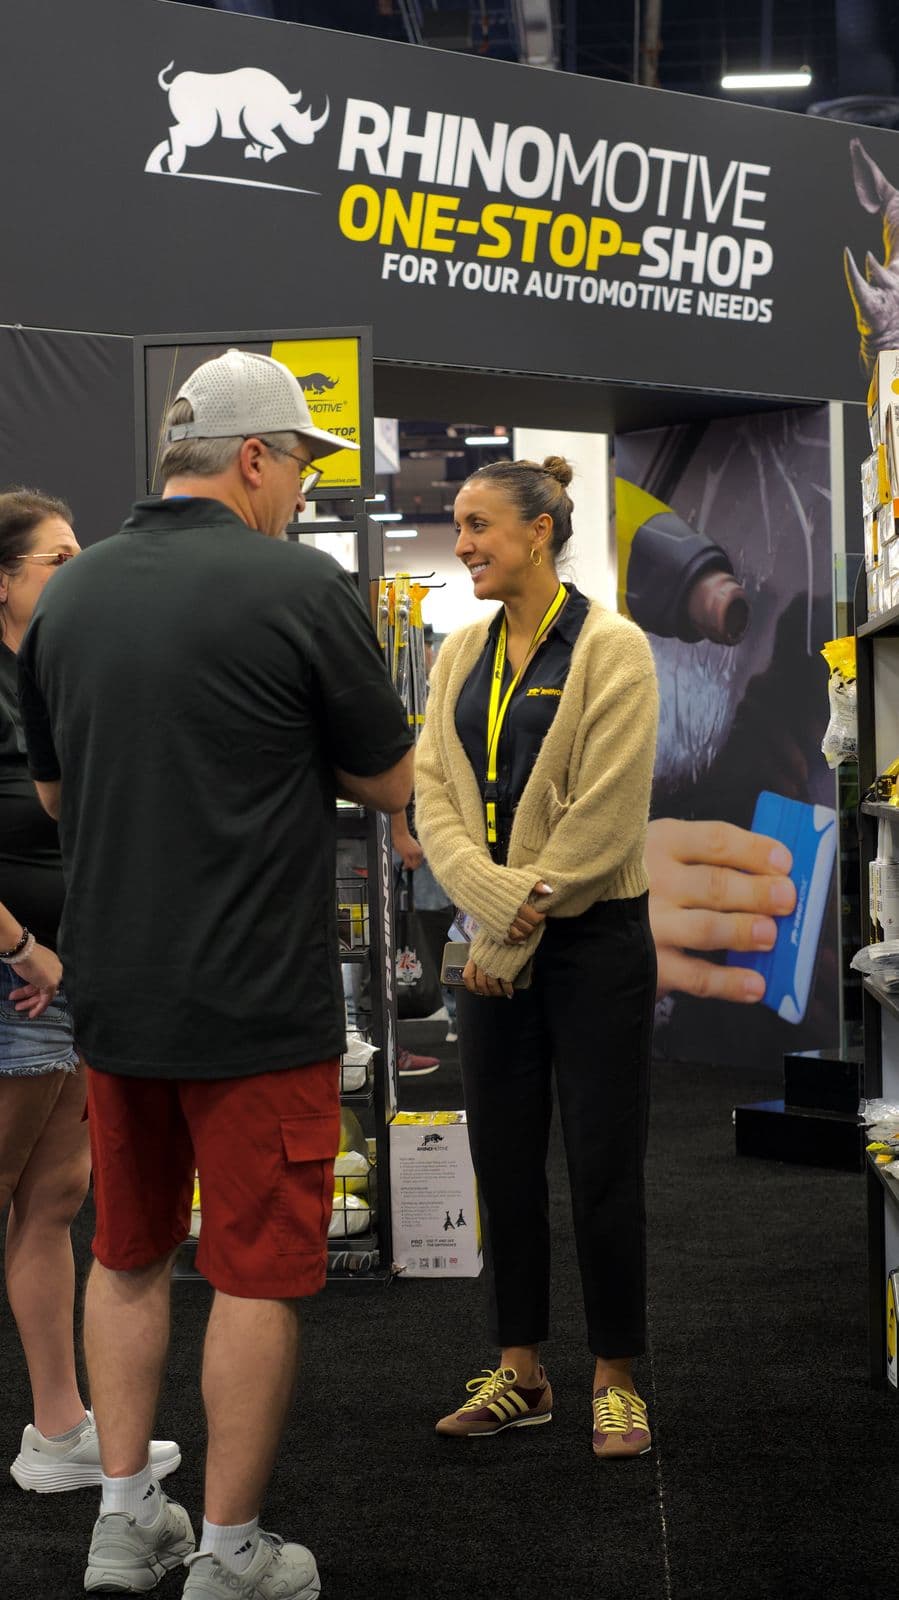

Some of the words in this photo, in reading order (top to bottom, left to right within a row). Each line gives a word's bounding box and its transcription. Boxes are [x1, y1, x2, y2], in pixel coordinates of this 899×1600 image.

[338, 98, 771, 231] RHINOMOTIVE
[339, 184, 774, 290] ONE-STOP-SHOP
[381, 252, 437, 285] FOR
[445, 260, 519, 295] YOUR
[524, 271, 693, 315] AUTOMOTIVE
[696, 291, 773, 323] NEEDS
[308, 402, 342, 413] MOTIVE
[381, 812, 392, 1001] RHINOM
